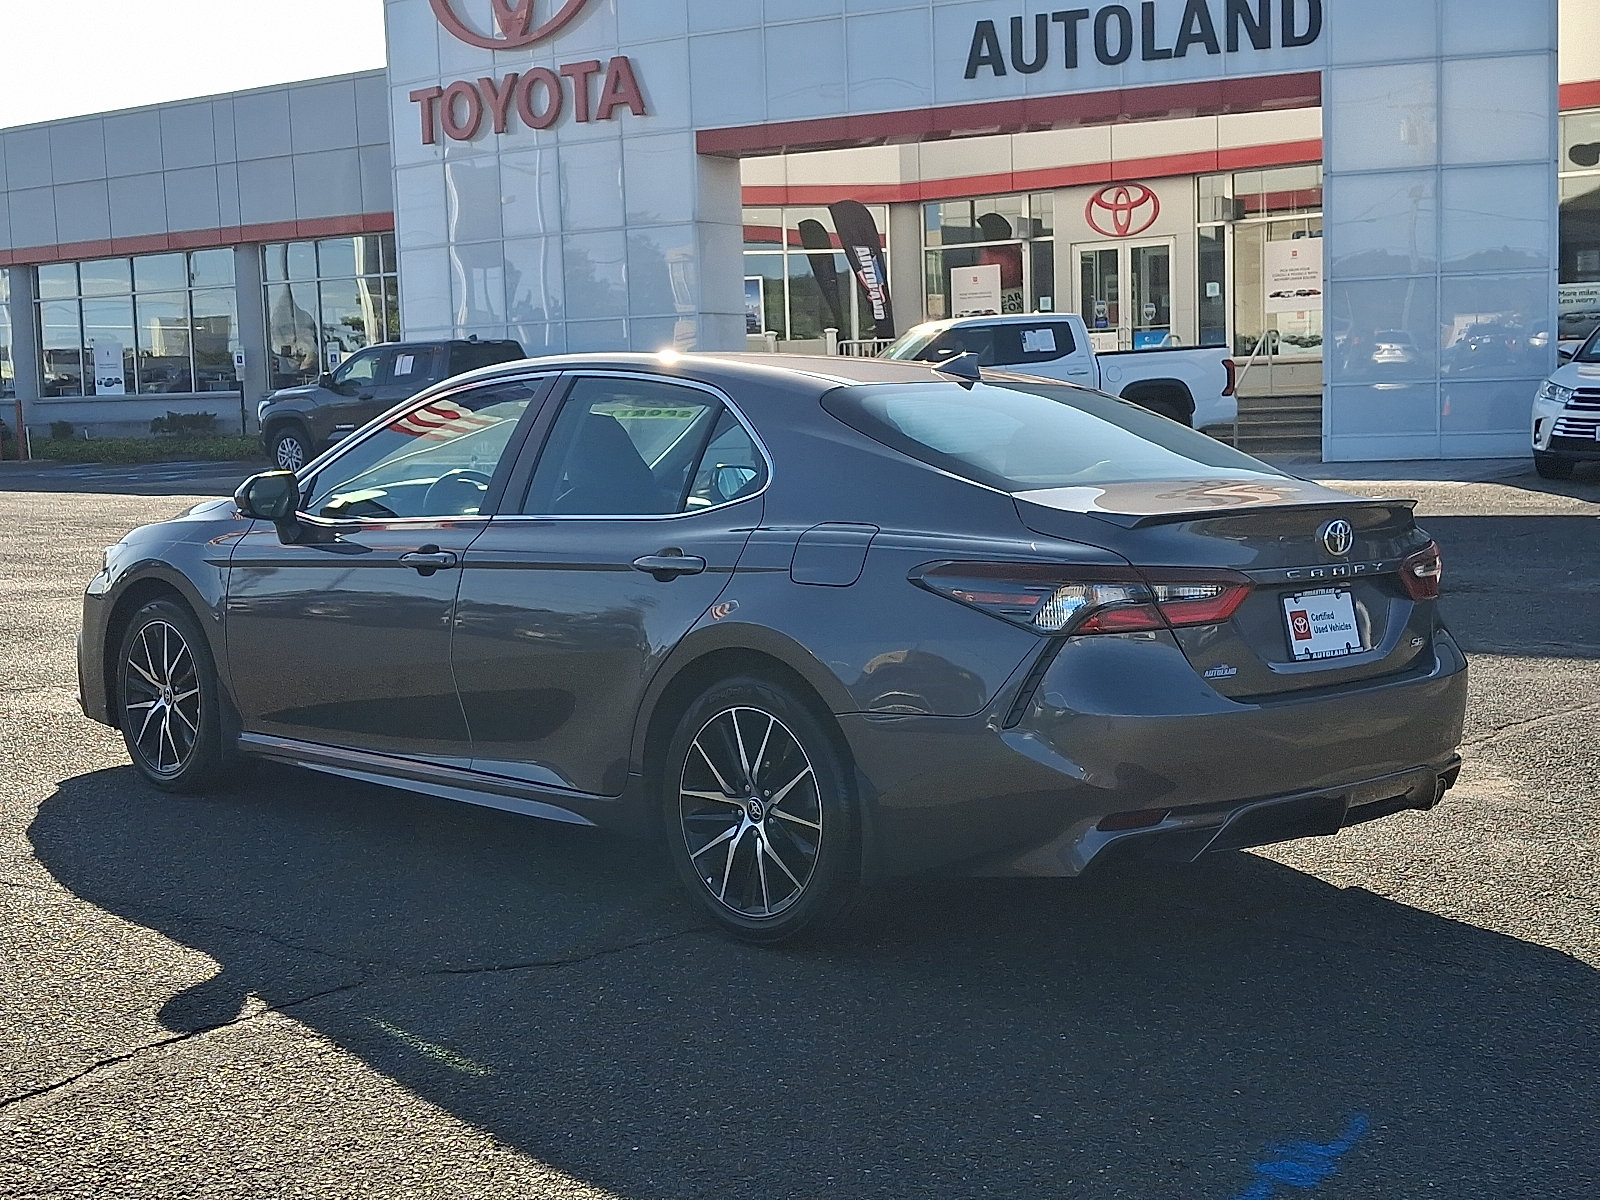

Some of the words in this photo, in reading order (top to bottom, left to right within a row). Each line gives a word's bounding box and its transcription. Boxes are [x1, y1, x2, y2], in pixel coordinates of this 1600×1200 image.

[964, 0, 1323, 79] AUTOLAND
[410, 56, 647, 145] TOYOTA
[853, 246, 886, 320] AUTOLAND
[1286, 562, 1384, 579] CAMRY
[1311, 611, 1335, 621] Certified
[1314, 625, 1329, 634] Used
[1329, 622, 1352, 632] Vehicles
[1411, 637, 1424, 647] SE
[1312, 649, 1348, 659] AUTOLAND
[1204, 667, 1237, 678] AUTOLAND
